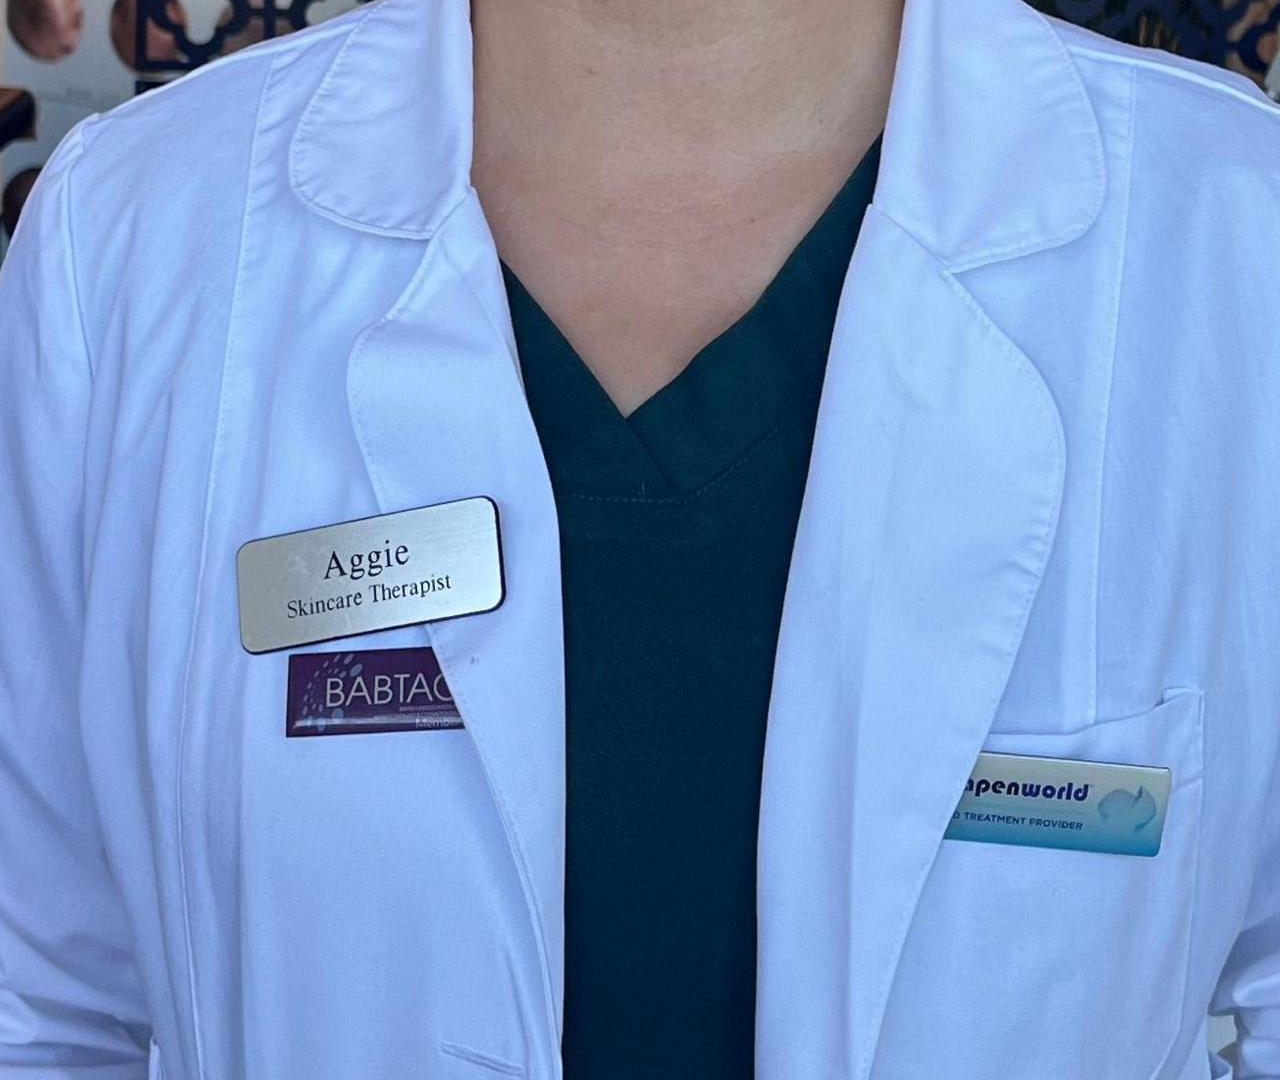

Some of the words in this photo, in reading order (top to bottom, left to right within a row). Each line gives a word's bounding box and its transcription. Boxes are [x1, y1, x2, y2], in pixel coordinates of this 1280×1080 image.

[324, 539, 410, 580] Aggie
[287, 592, 362, 619] Skincare
[369, 574, 452, 603] Therapist
[965, 811, 1026, 825] TREATMENT
[1029, 818, 1084, 831] PROVIDER
